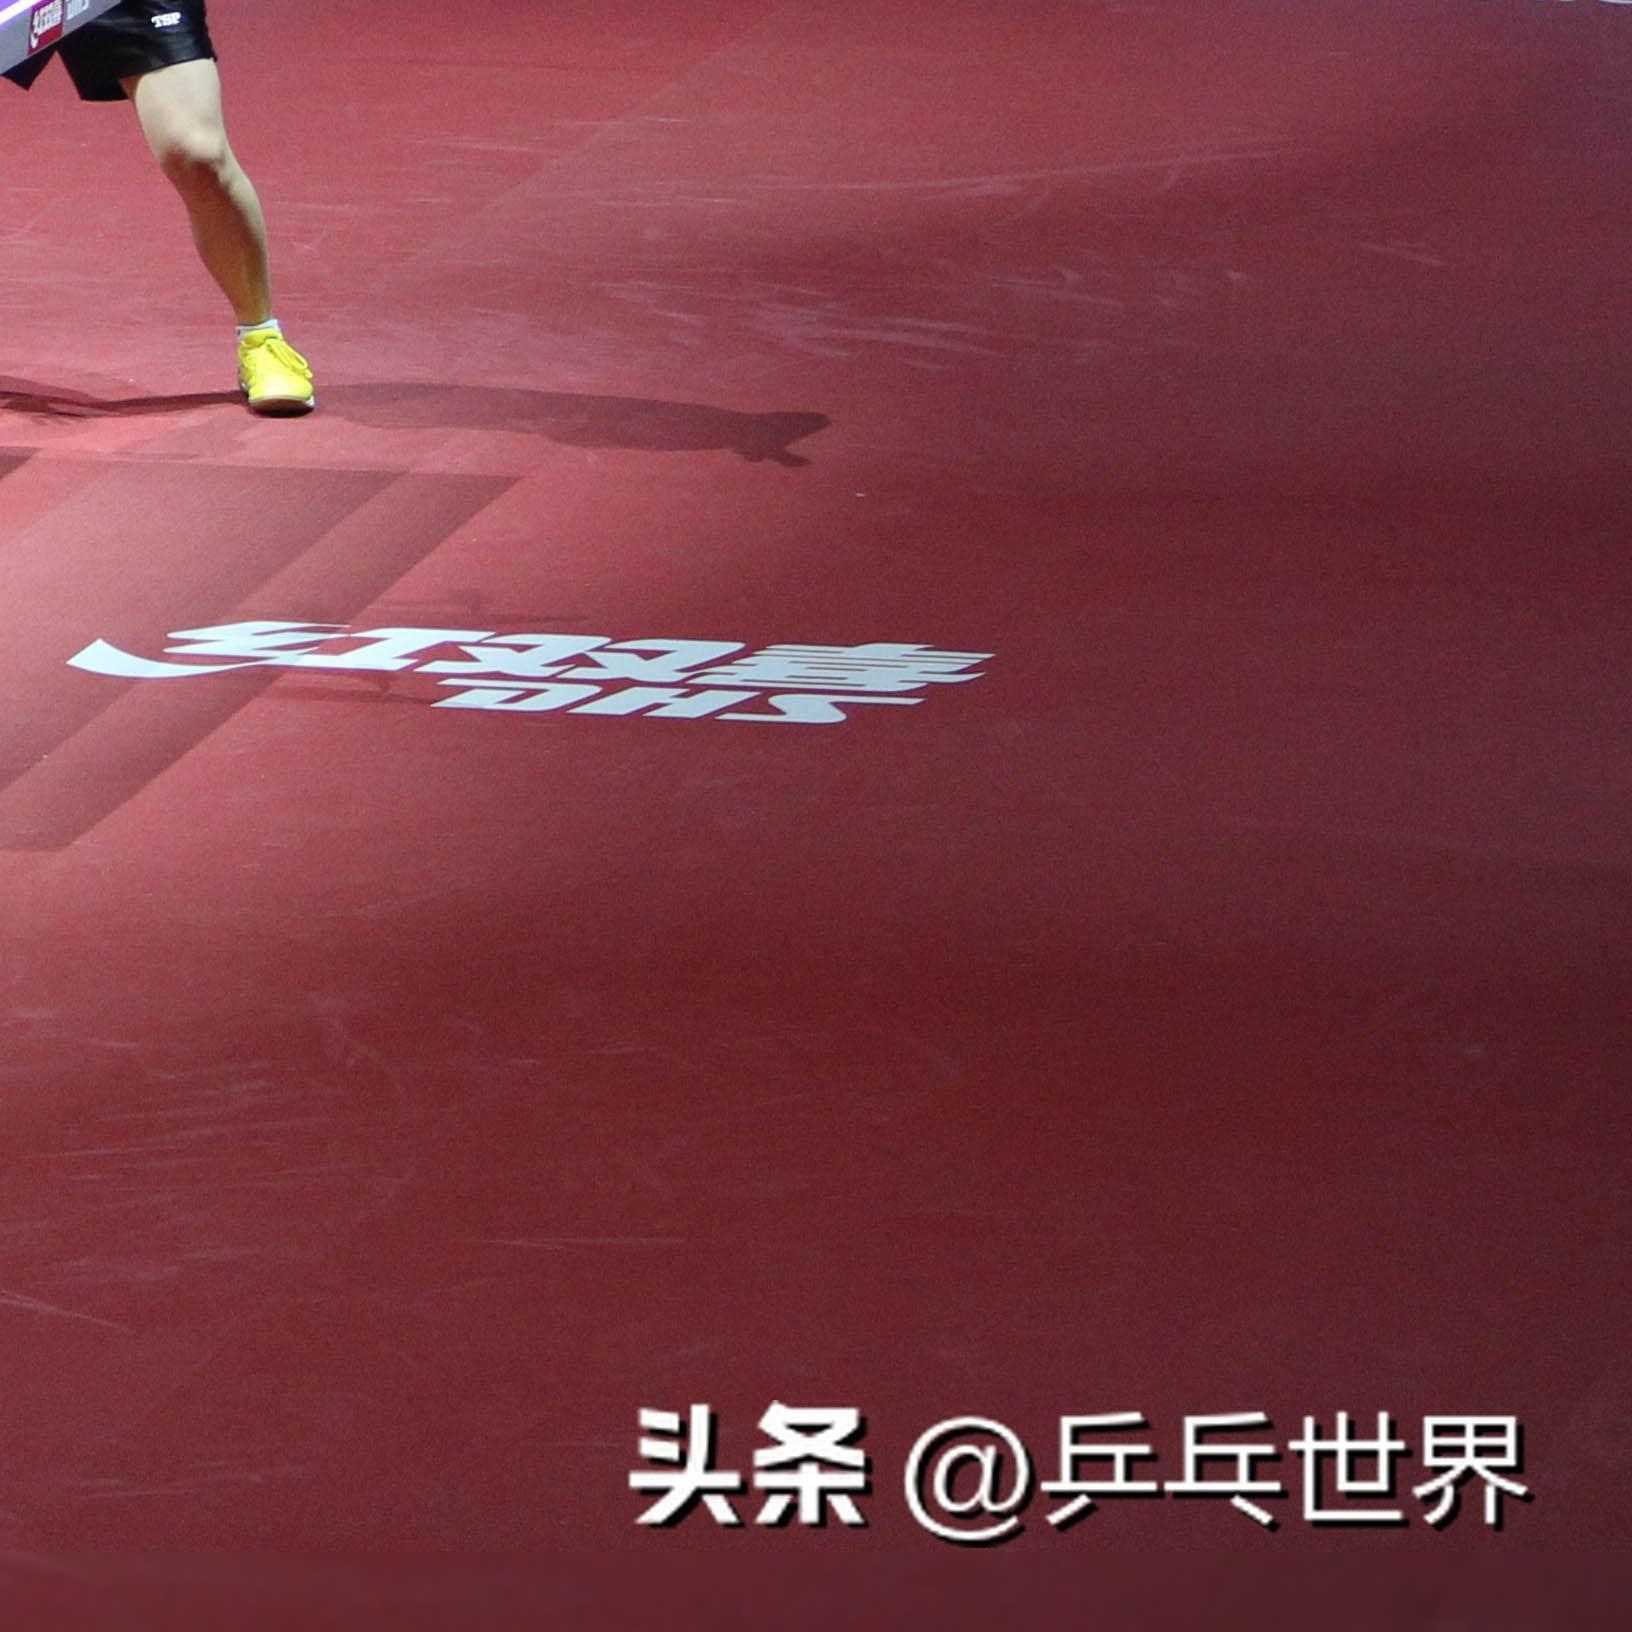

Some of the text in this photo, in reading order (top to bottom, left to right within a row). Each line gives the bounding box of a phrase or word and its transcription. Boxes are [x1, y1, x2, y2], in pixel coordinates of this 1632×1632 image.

[65, 621, 996, 694] 红双喜
[430, 678, 926, 724] DHS
